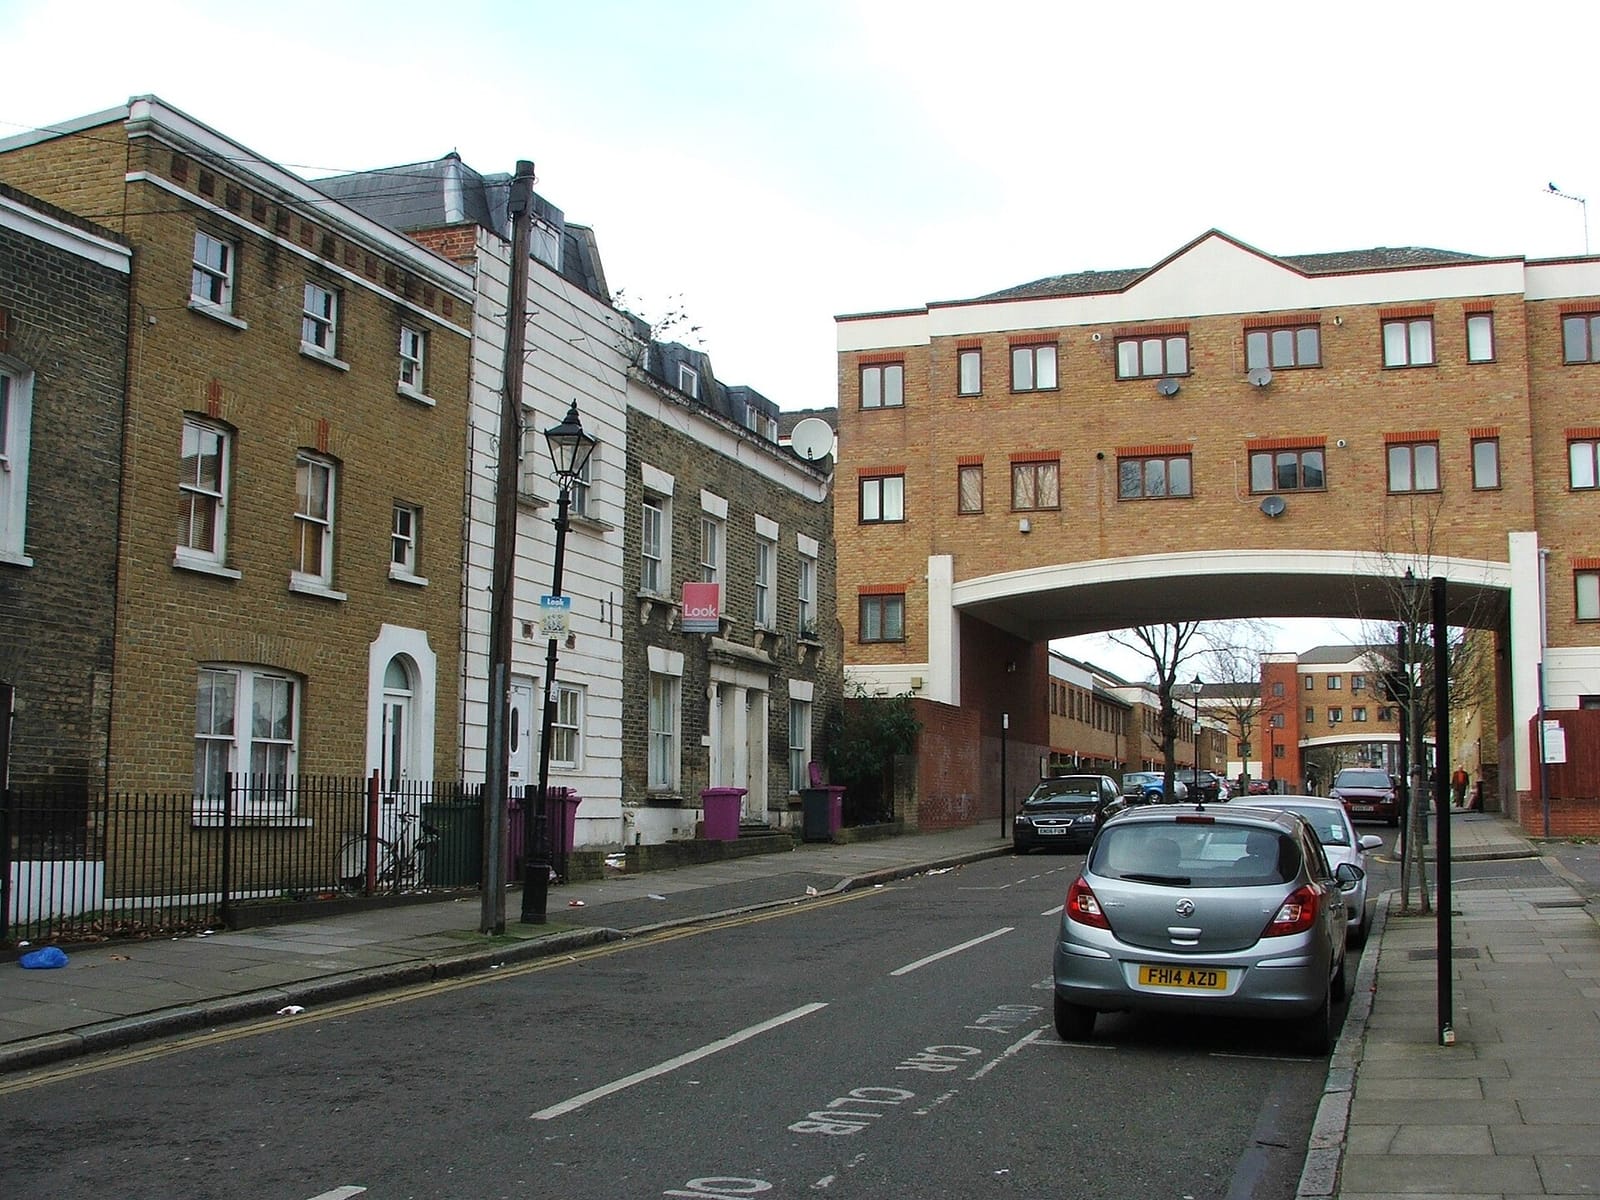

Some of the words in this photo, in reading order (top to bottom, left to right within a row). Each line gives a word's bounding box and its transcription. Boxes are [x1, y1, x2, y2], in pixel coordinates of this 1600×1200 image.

[684, 603, 717, 617] Look
[1148, 968, 1183, 985] FH14
[1187, 970, 1217, 987] AZD
[895, 1045, 982, 1072] CAR
[787, 1087, 916, 1136] CLUB
